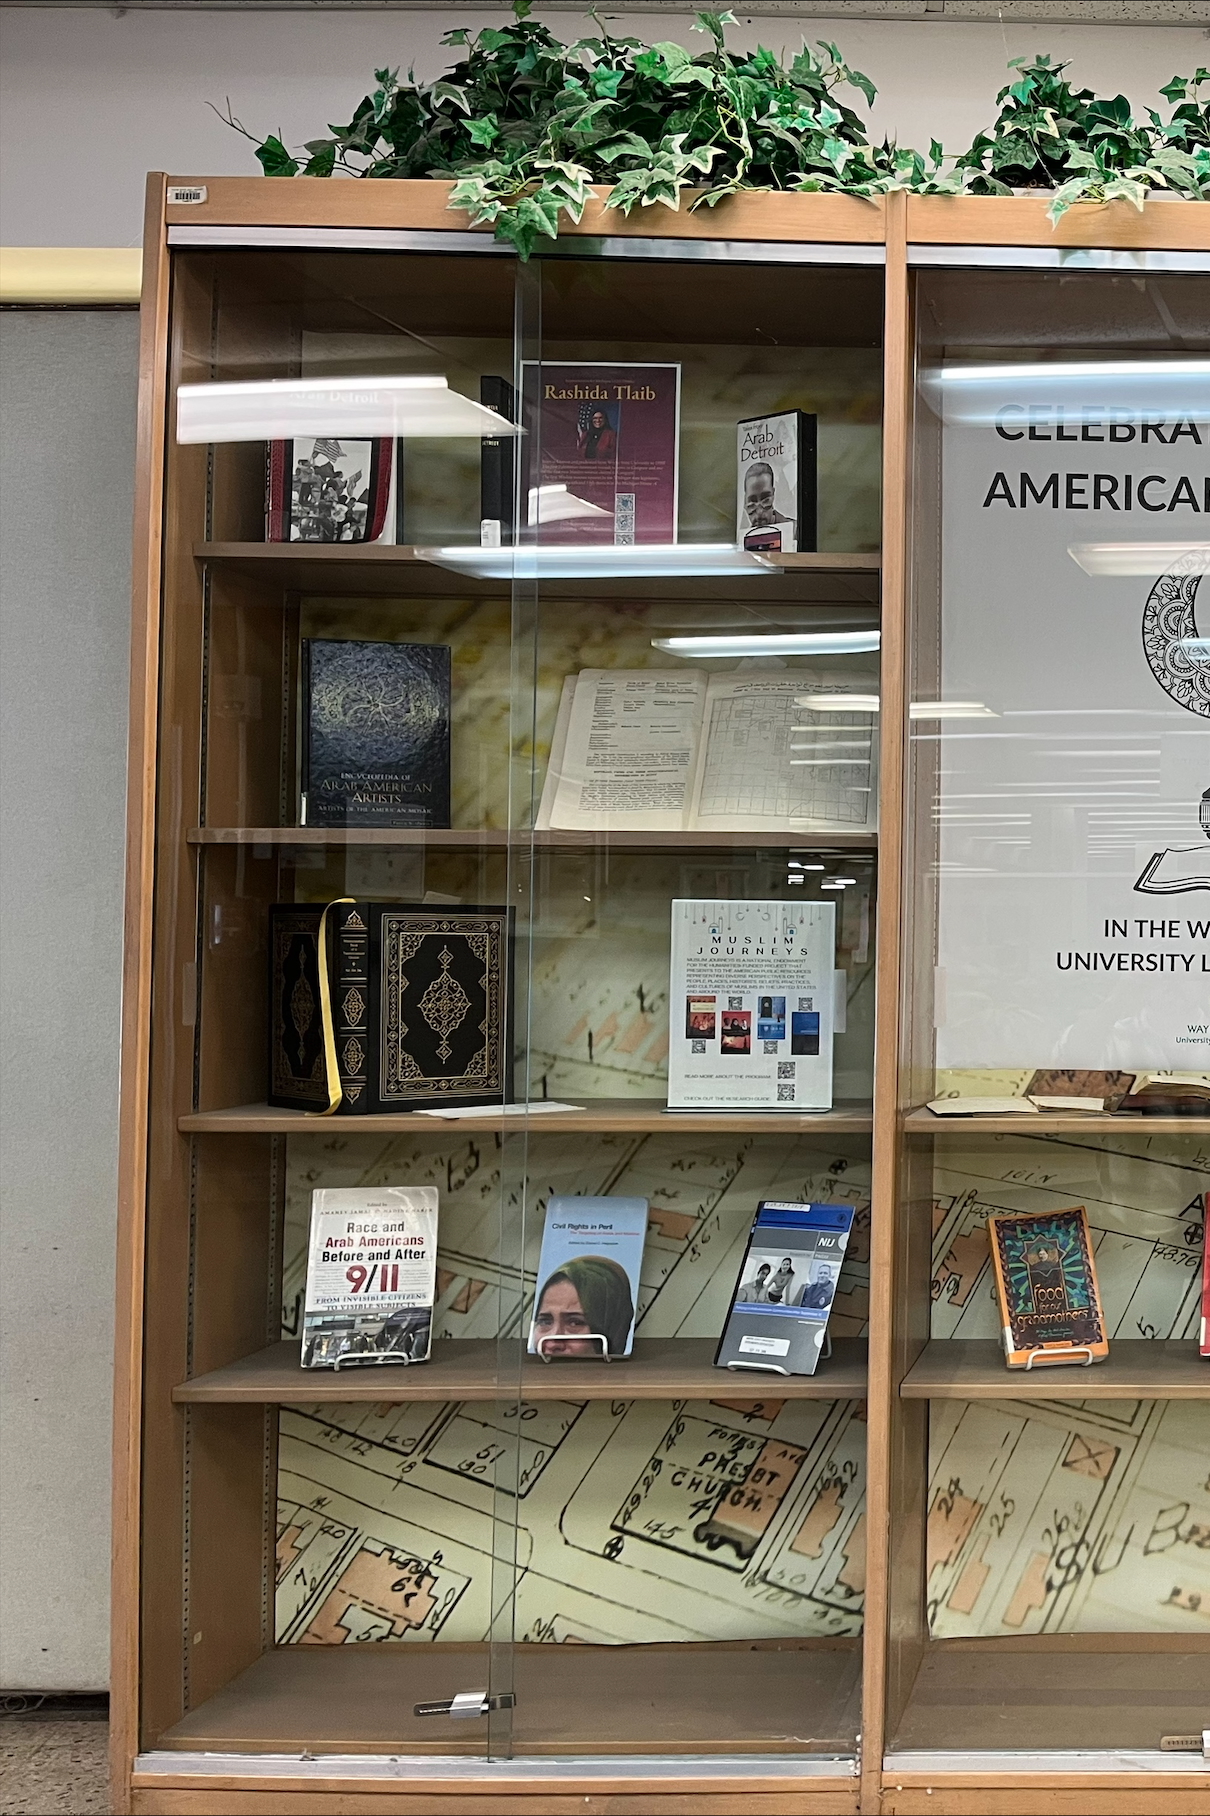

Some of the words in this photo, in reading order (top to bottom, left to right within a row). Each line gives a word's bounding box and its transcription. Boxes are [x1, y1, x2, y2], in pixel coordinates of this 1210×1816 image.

[544, 385, 608, 400] Rashida
[613, 385, 656, 401] Tlaib
[742, 424, 774, 447] Arab
[741, 441, 785, 462] Detroit
[340, 772, 399, 781] ENCYCLOPEDIA
[320, 779, 358, 791] ARAB
[361, 781, 433, 793] AMERICAN
[351, 792, 402, 804] ARTISTS
[1104, 919, 1128, 938] IN
[1134, 919, 1180, 939] THE
[711, 936, 795, 945] MUSLIM
[696, 946, 809, 956] JOURNEYS
[1056, 952, 1196, 972] UNIVERSITY
[346, 1222, 378, 1233] Race
[382, 1221, 405, 1232] and
[567, 1223, 589, 1231] Rights
[325, 1236, 354, 1248] Arab
[358, 1235, 424, 1247] Americans
[817, 1237, 836, 1248] NIJ
[322, 1251, 364, 1263] Before
[368, 1249, 391, 1261] and
[395, 1248, 426, 1260] After
[345, 1264, 399, 1294] 9/11
[343, 1294, 387, 1303] INVISIBLE
[388, 1293, 427, 1301] CITIZENS
[1033, 1283, 1065, 1307] food
[1017, 1309, 1089, 1334] grandmothers
